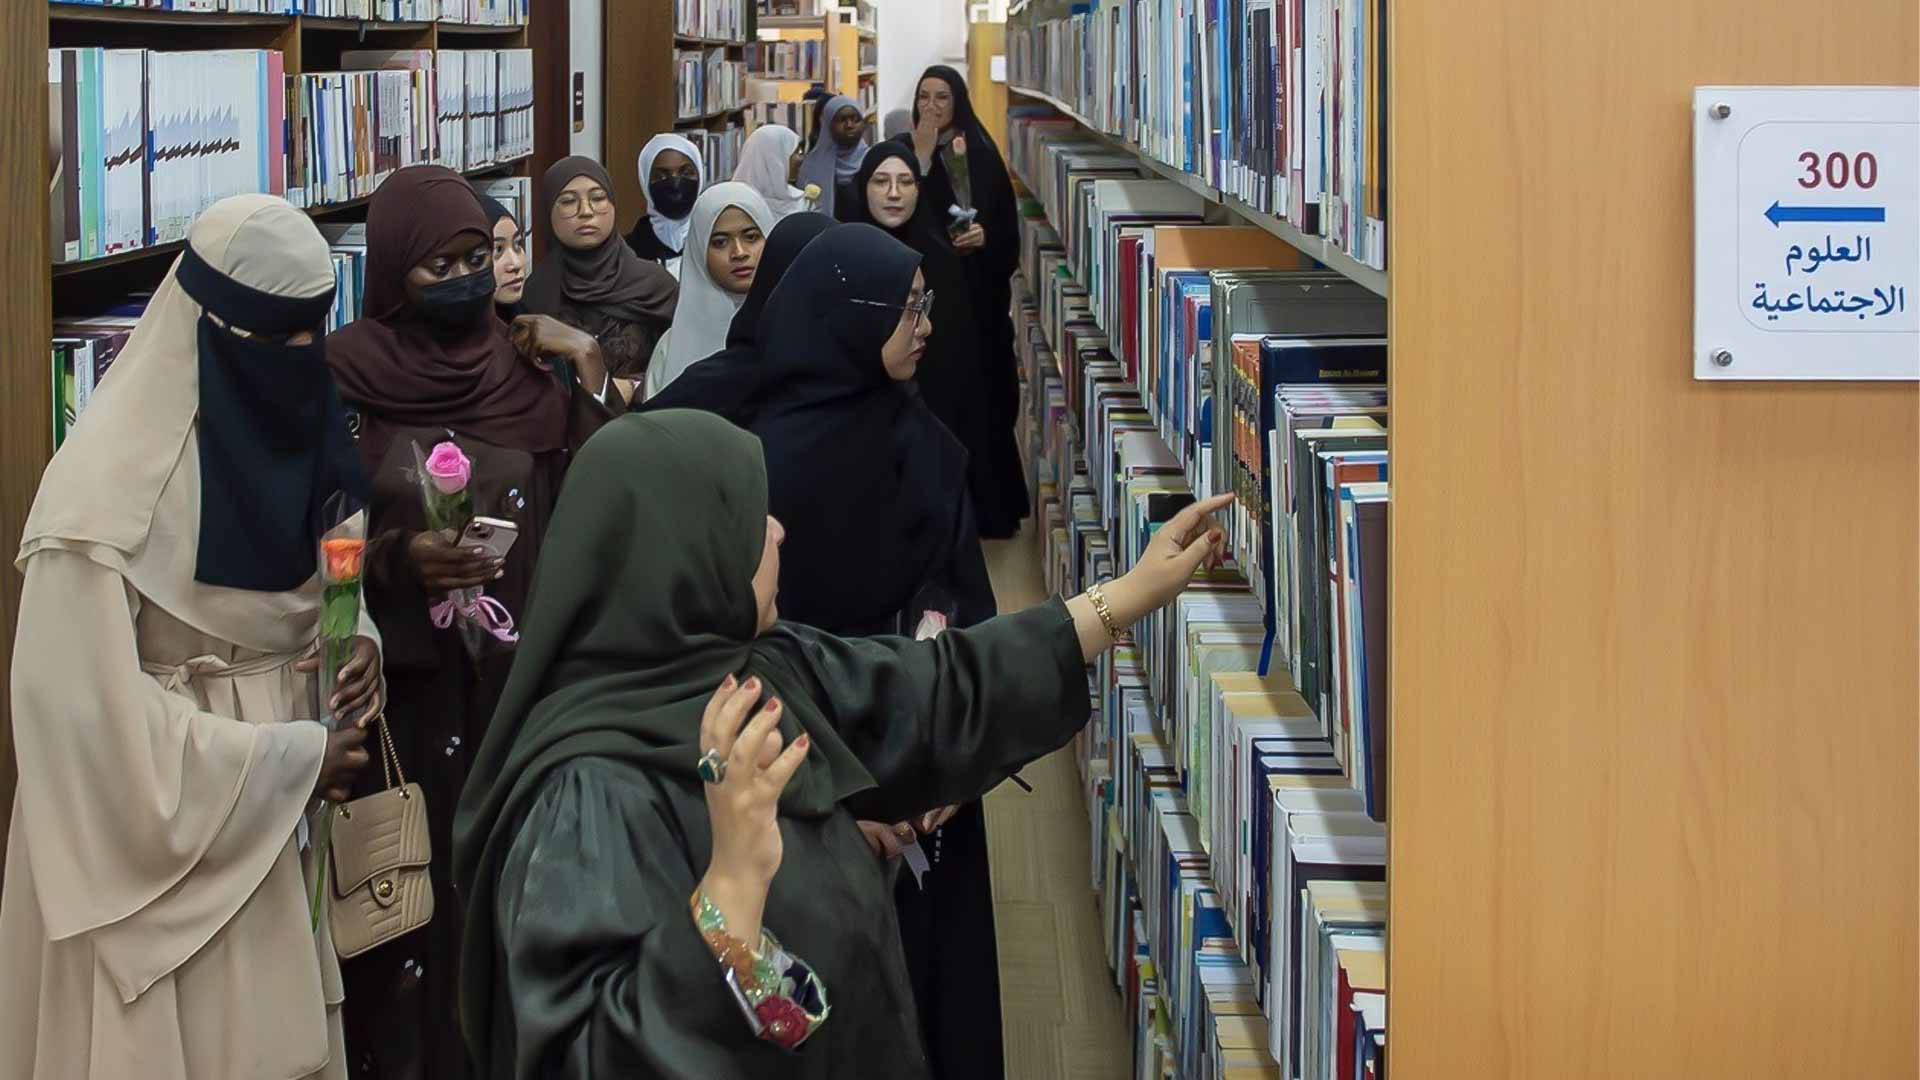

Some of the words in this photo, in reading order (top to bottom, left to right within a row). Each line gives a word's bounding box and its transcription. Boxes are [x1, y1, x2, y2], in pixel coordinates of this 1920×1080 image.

[1798, 152, 1877, 189] 300
[1786, 235, 1870, 275] العلوم
[1752, 283, 1904, 320] الاجتماعية
